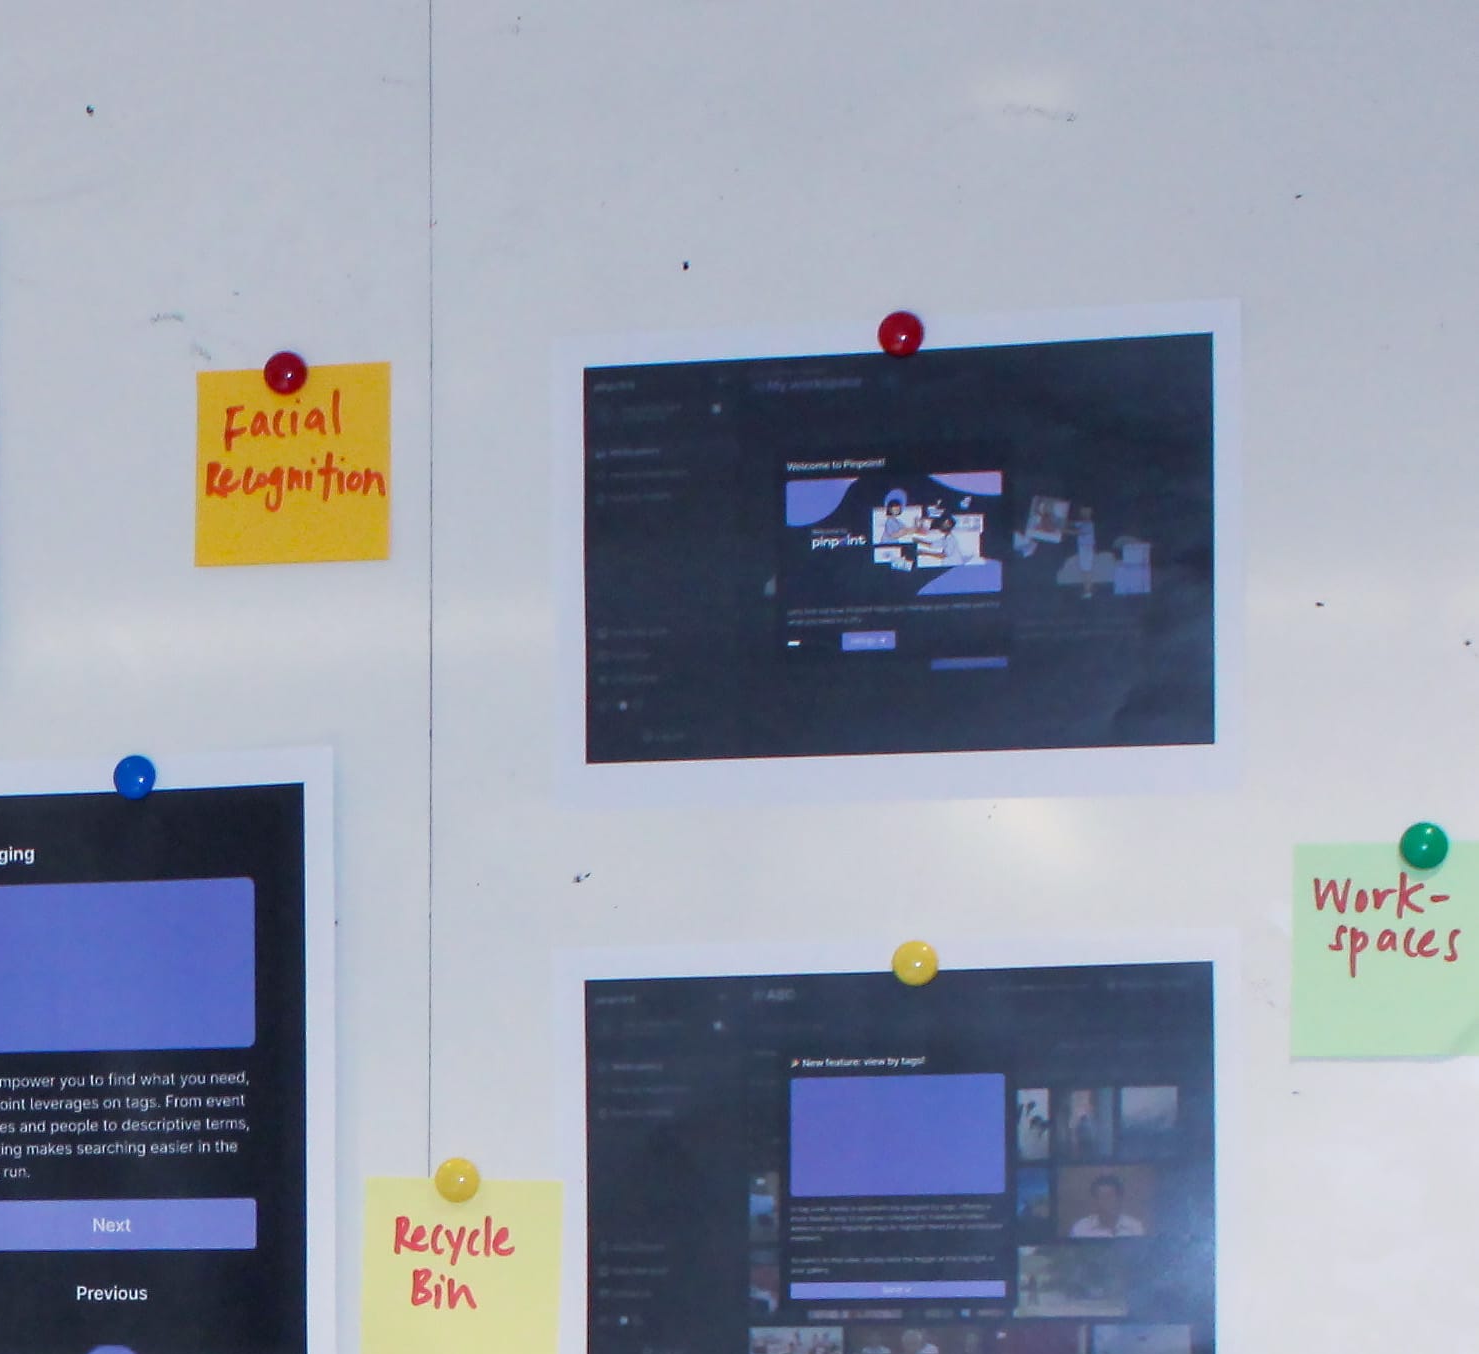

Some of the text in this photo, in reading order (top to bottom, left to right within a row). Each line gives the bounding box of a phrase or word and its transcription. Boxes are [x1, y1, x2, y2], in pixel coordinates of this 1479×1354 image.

[223, 388, 341, 451] Facial
[205, 451, 386, 512] Recognition
[1313, 871, 1451, 919] Work-
[1328, 924, 1462, 979] spaces
[59, 1077, 85, 1090] you
[89, 1074, 103, 1086] to
[108, 1072, 135, 1086] find
[140, 1073, 175, 1085] what
[180, 1074, 205, 1088] you
[210, 1071, 249, 1085] need,
[30, 1098, 99, 1112] leverages
[102, 1098, 121, 1109] on
[125, 1096, 160, 1111] tags.
[165, 1094, 201, 1107] From
[206, 1094, 245, 1107] event
[19, 1121, 45, 1132] and
[50, 1119, 98, 1134] people
[103, 1119, 117, 1131] to
[121, 1118, 201, 1131] descriptive
[205, 1118, 249, 1131] terms,
[26, 1143, 72, 1155] makes
[77, 1142, 146, 1156] searching
[150, 1143, 193, 1153] easier
[198, 1142, 210, 1152] in
[215, 1140, 237, 1152] the
[3, 1167, 29, 1178] run.
[93, 1217, 131, 1232] Next
[393, 1215, 516, 1266] Recycle
[76, 1285, 147, 1300] Previous
[411, 1268, 478, 1310] Bin
